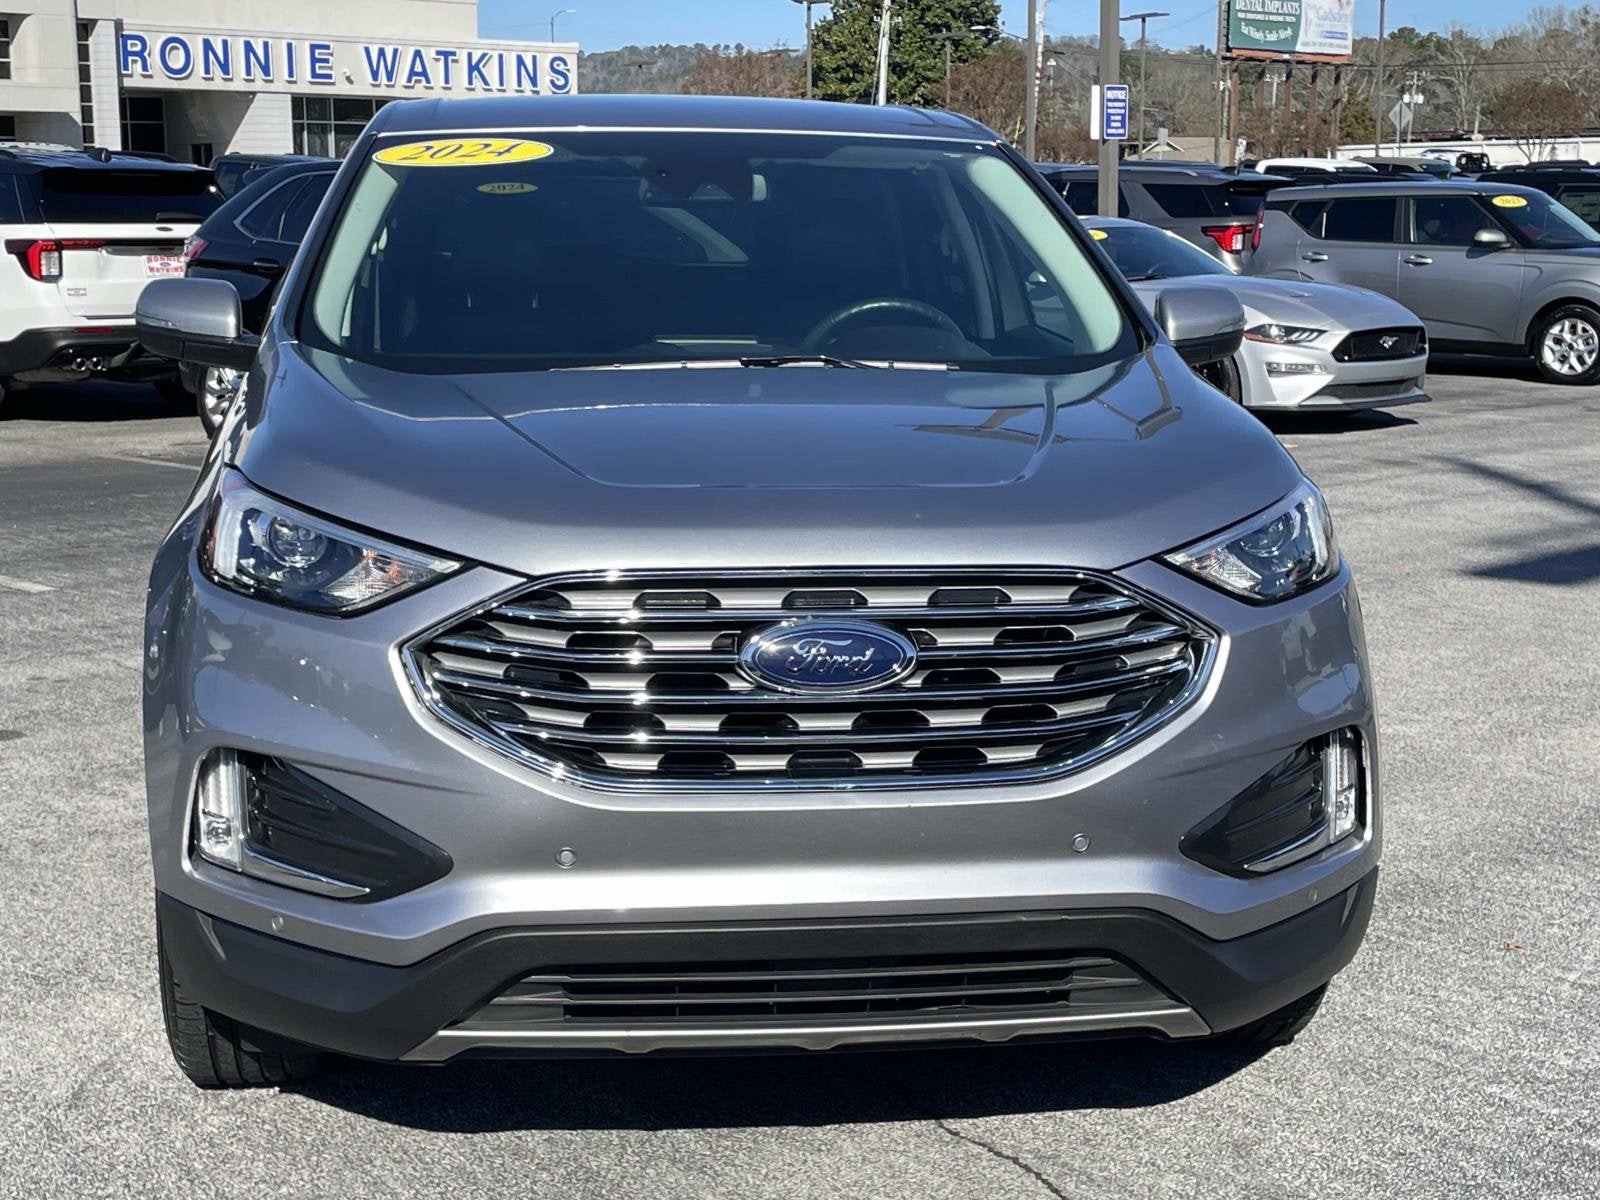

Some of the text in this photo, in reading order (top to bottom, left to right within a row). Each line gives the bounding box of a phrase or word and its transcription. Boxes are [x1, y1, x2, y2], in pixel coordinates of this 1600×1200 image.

[1264, 0, 1301, 15] IMPLANTS
[121, 33, 572, 93] RONNIE WATKINS
[397, 142, 525, 161] 2024
[488, 183, 525, 192] 2024
[784, 637, 876, 674] Ford
